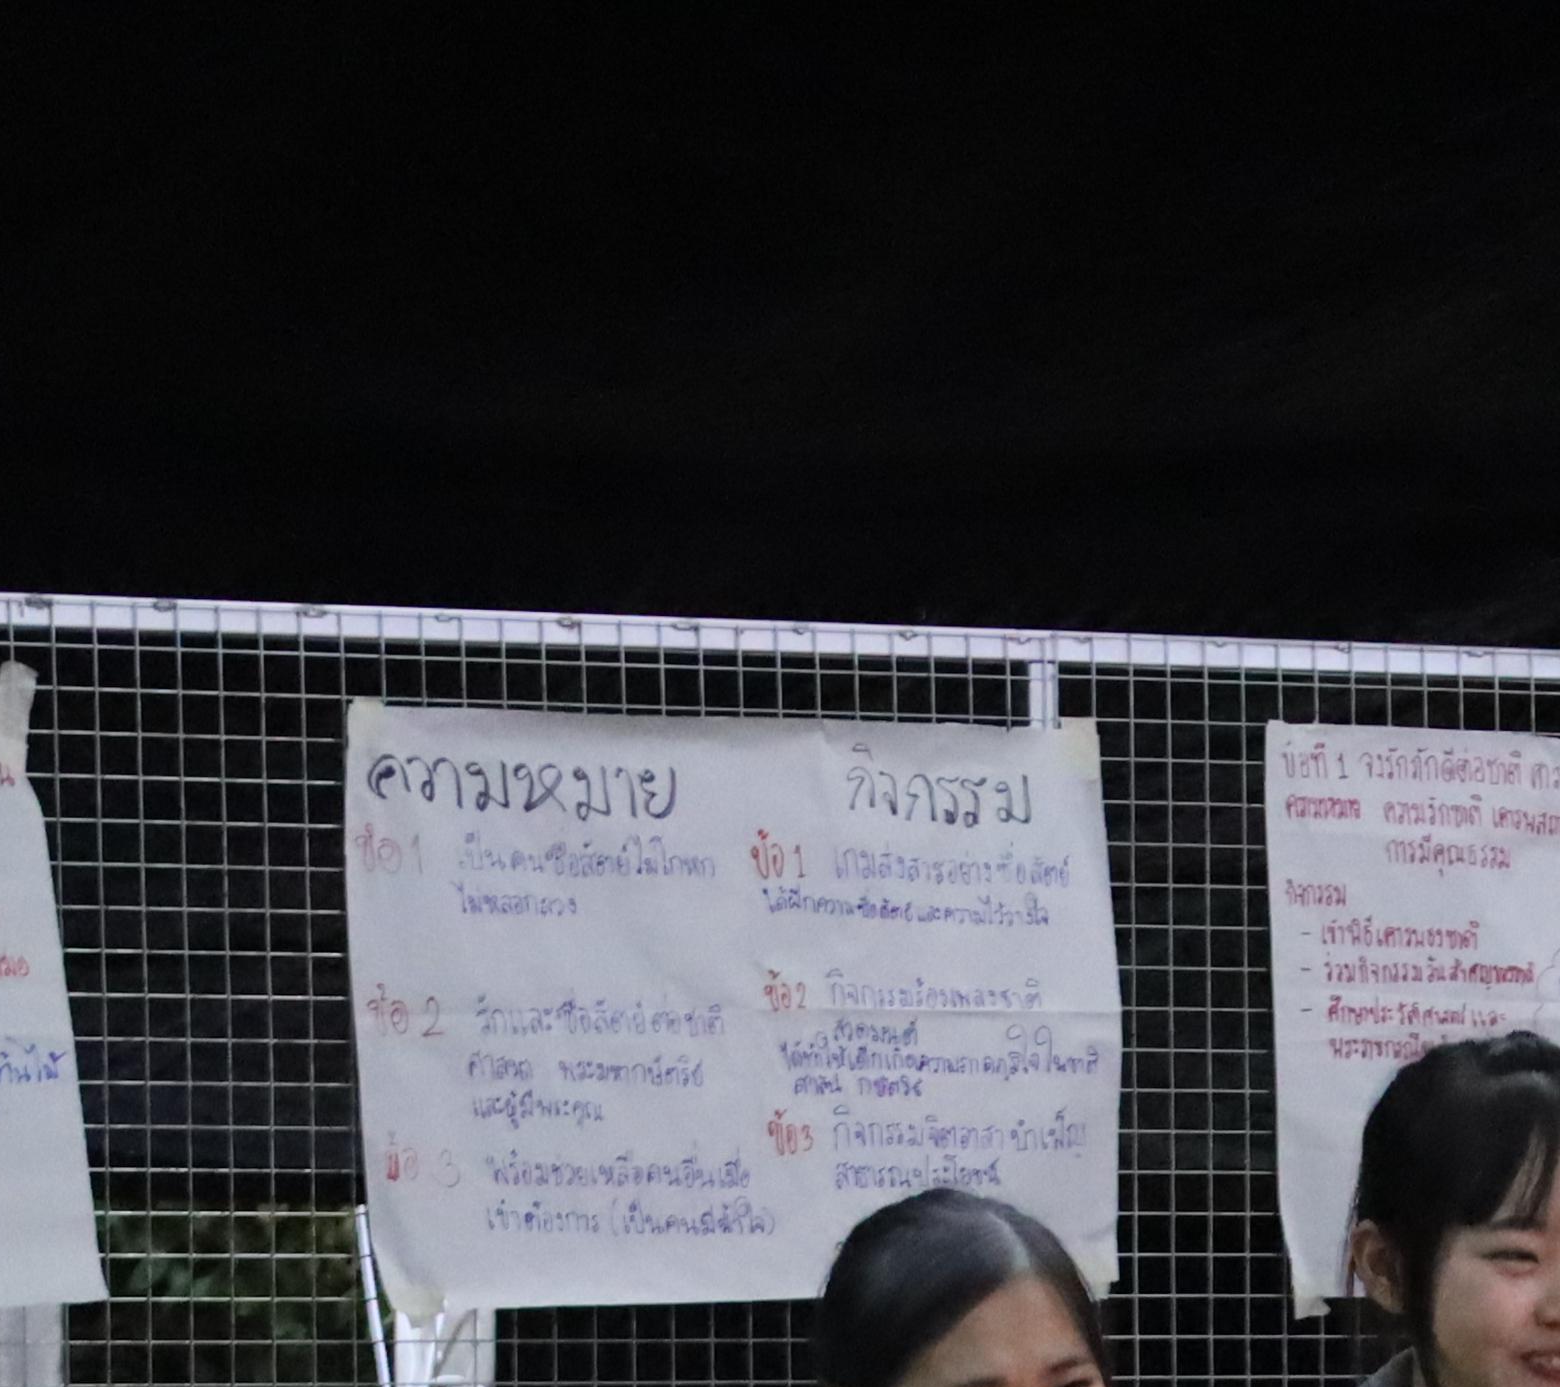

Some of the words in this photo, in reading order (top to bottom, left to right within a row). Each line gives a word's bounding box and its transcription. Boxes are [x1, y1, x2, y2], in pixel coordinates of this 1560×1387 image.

[366, 753, 678, 821] ความหมาย
[846, 742, 1032, 828] กิจกรรม
[354, 822, 403, 874] ข้อ
[749, 827, 785, 880] ข้อ
[366, 982, 410, 1037] ข้อ
[421, 995, 446, 1037] 2
